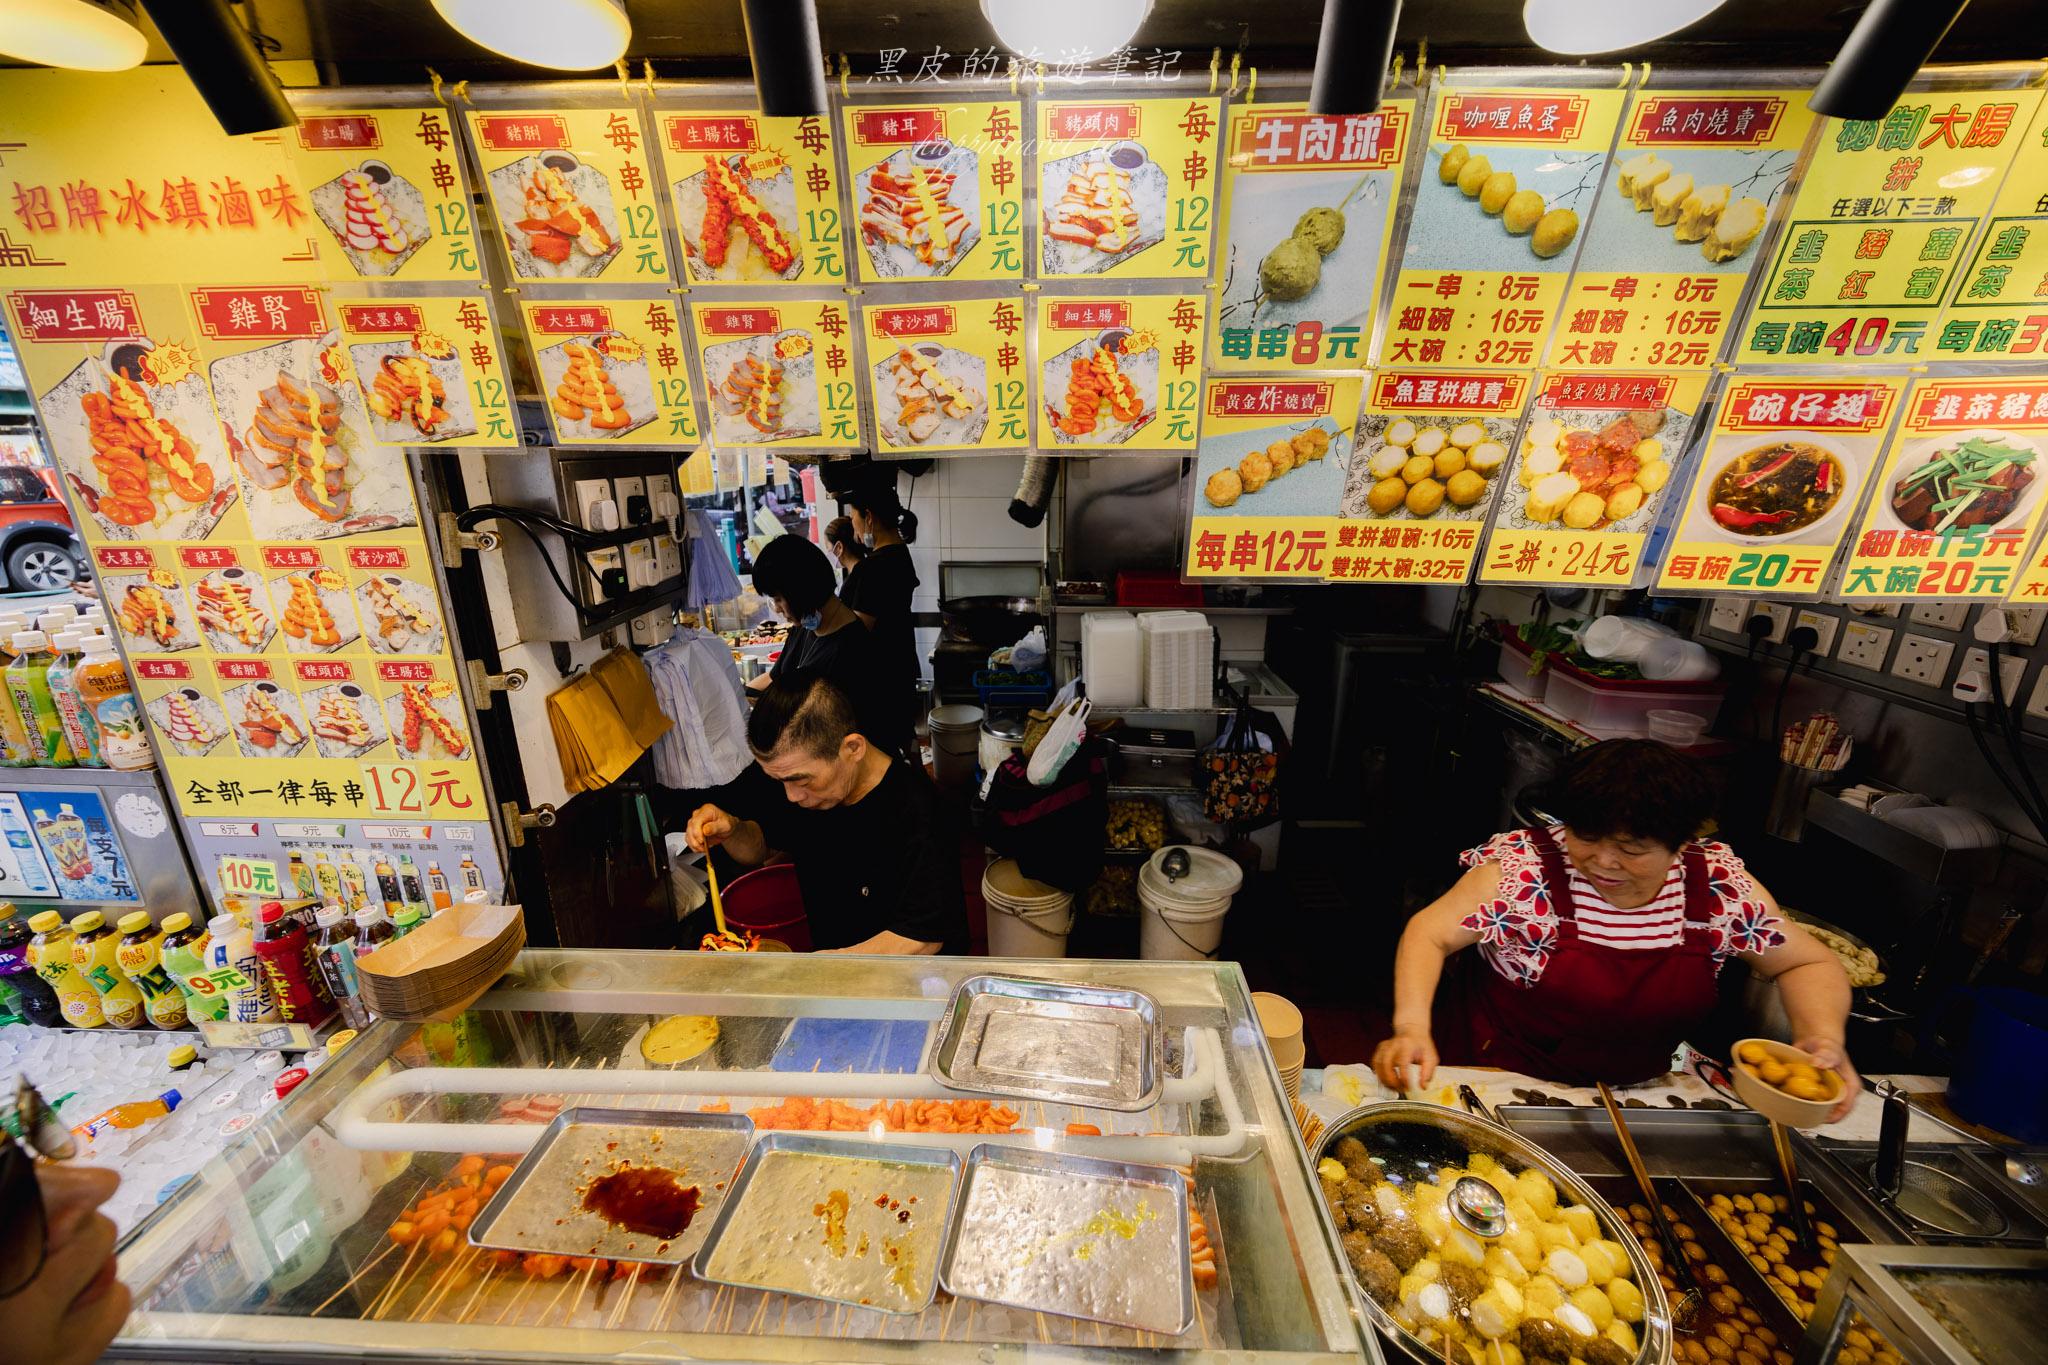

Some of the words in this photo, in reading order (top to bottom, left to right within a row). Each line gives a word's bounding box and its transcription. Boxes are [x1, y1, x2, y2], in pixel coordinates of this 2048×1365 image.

[881, 116, 919, 137] 豬耳
[1064, 110, 1120, 133] 豬頭肉
[1463, 104, 1561, 133] 咖喱魚蛋
[1653, 107, 1756, 137] 魚肉燒賣
[321, 123, 355, 143] 紅腸
[687, 124, 741, 144] 生腸花
[1254, 116, 1383, 163] 牛肉球
[1881, 157, 1924, 192] 拼
[11, 174, 308, 236] 招牌冰鎮滷味
[1830, 196, 1957, 218] 任選以下三款
[29, 298, 127, 334] 細生腸
[228, 295, 293, 332] 雞腎
[359, 311, 409, 329] 大墨魚
[547, 312, 596, 329] 大生腸
[724, 313, 754, 329] 雞腎
[888, 313, 939, 331] 黃沙潤
[1064, 308, 1114, 324] 細生腸
[1220, 320, 1362, 366] 每串8元
[1750, 316, 1929, 356] 每碗40元
[1225, 385, 1319, 412] 黃金炸燒賣
[1393, 377, 1506, 407] 魚蛋拼燒賣
[1558, 381, 1658, 403] 魚蛋/燒賣/牛肉
[1747, 391, 1870, 425] 碗仔翅
[1195, 529, 1328, 574] 每串12元
[1857, 523, 2027, 558] 細碗15元
[105, 549, 148, 566] 大墨魚
[195, 550, 222, 565] 豬耳
[272, 549, 313, 566] 大生腸
[356, 549, 401, 566] 黃沙潤
[1667, 553, 1824, 588] 每碗20元
[1845, 561, 2012, 595] 大碗20元
[149, 662, 177, 676] 紅腸
[304, 663, 345, 679] 豬頭肉
[386, 664, 428, 679] 生腸花
[186, 766, 473, 812] 全部一律每串12元
[220, 823, 239, 835] 8元
[302, 825, 322, 837] 9元
[386, 827, 411, 838] 10元
[226, 862, 276, 893] 10元
[190, 969, 247, 995] 9元
[263, 960, 296, 1020] 王老吉
